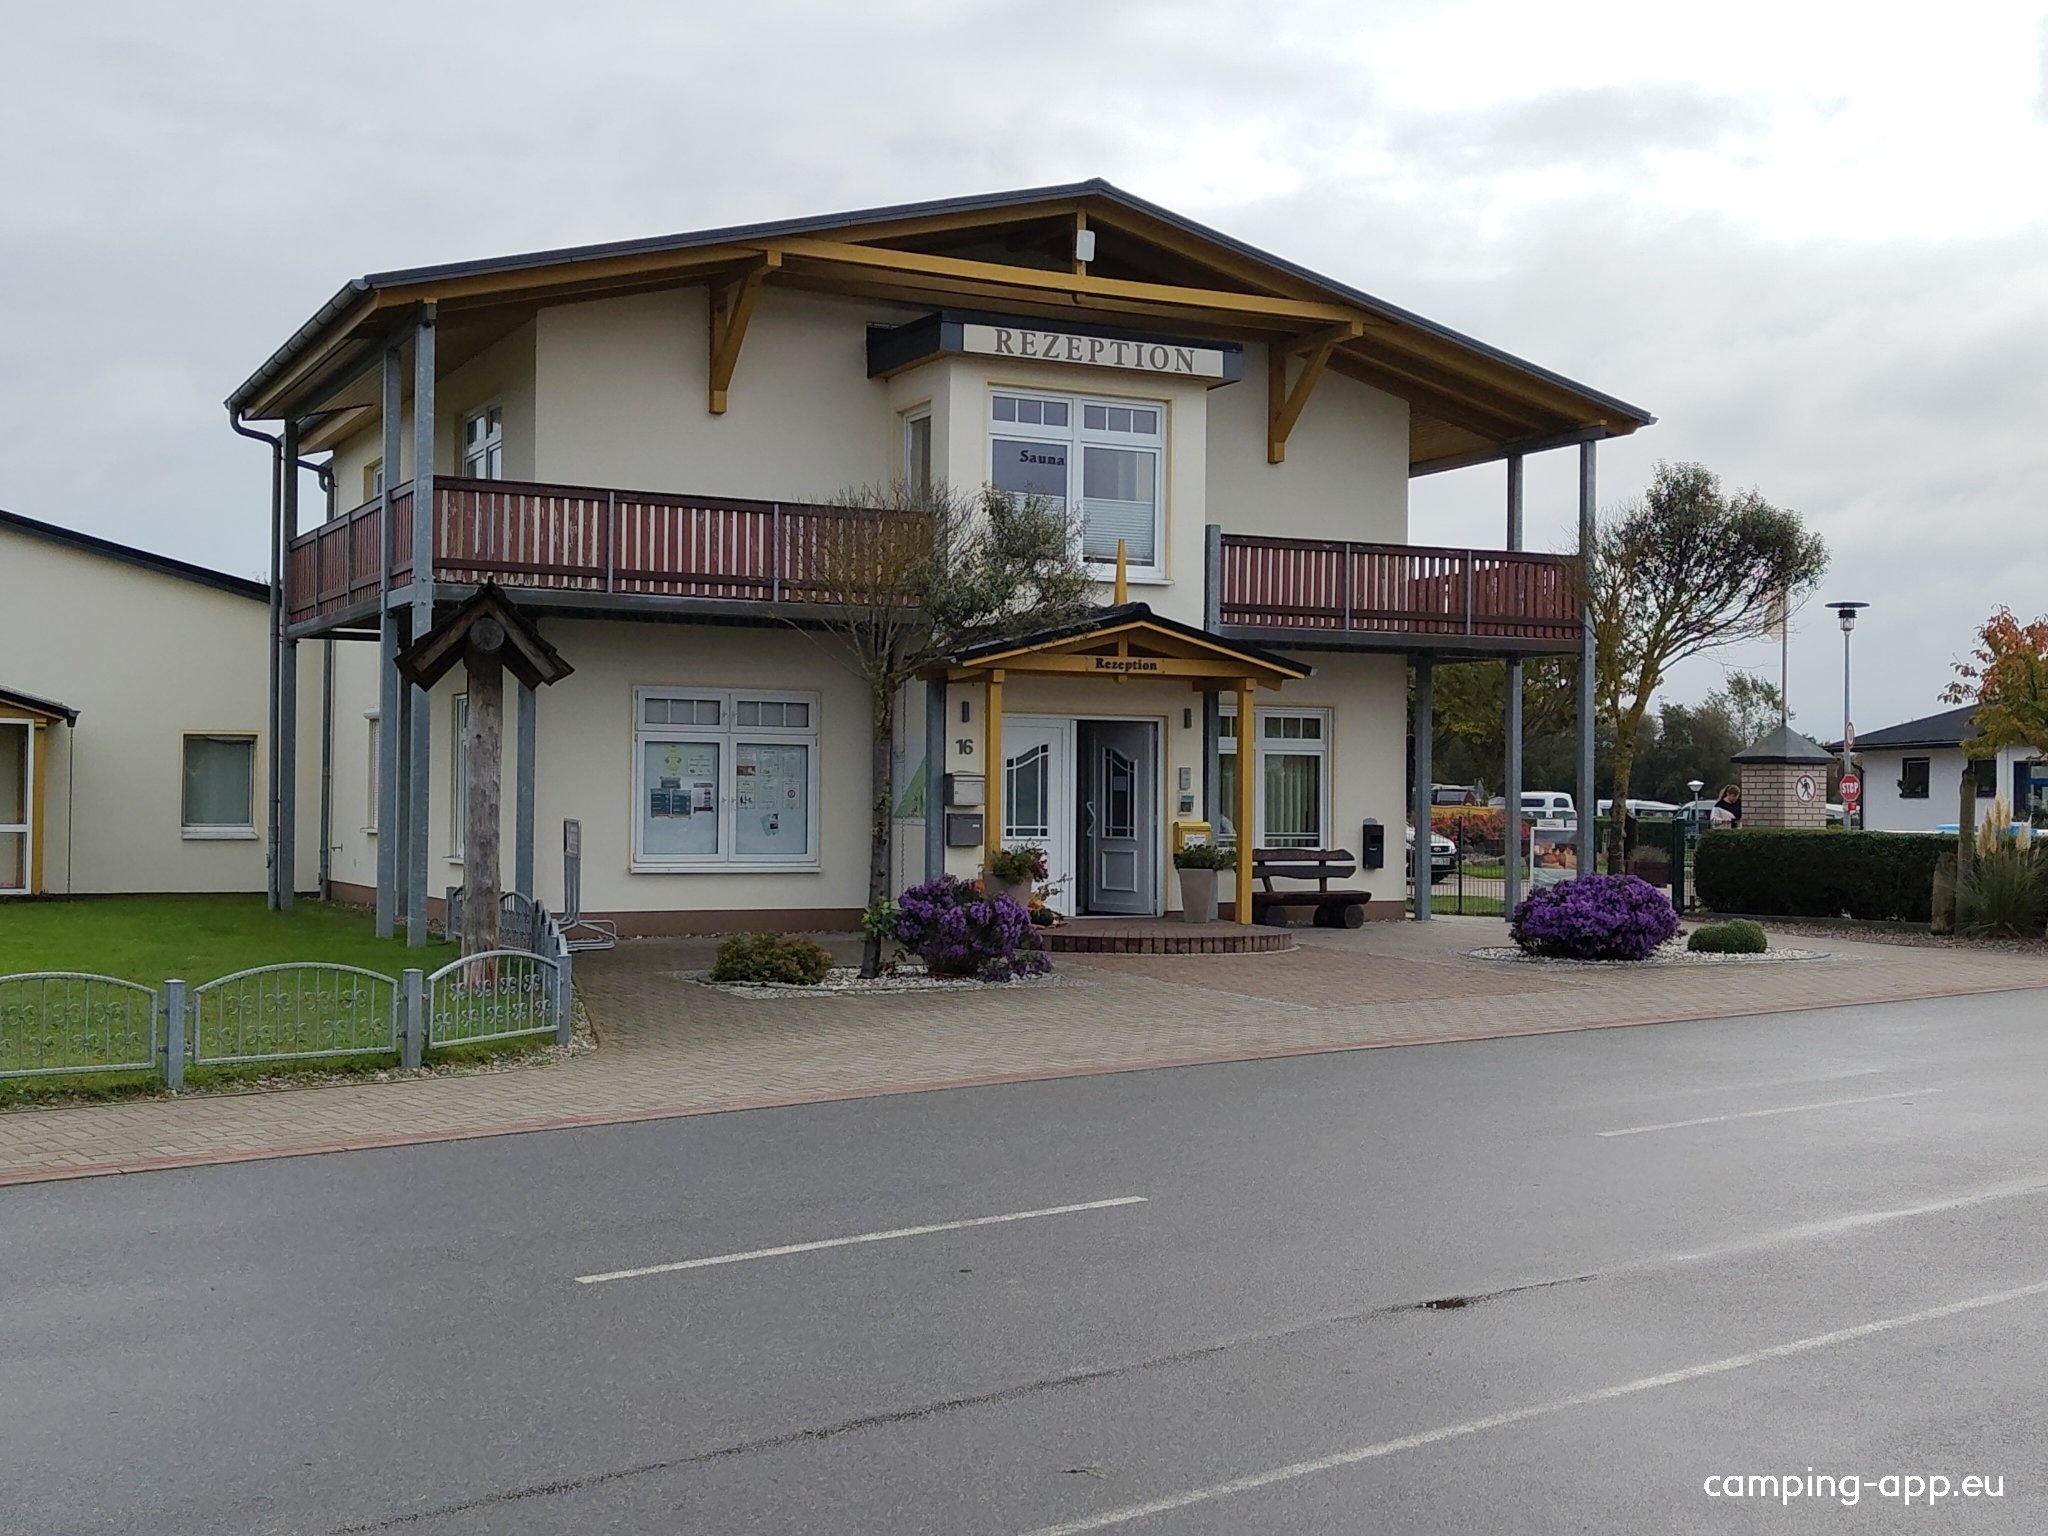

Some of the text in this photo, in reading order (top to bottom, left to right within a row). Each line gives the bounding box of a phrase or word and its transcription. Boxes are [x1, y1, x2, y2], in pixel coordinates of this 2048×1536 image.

[994, 328, 1195, 373] REZEPTION
[1019, 449, 1065, 466] Sauna
[1095, 657, 1157, 672] Rezeption
[955, 738, 974, 755] 16
[1841, 782, 1859, 794] STOP
